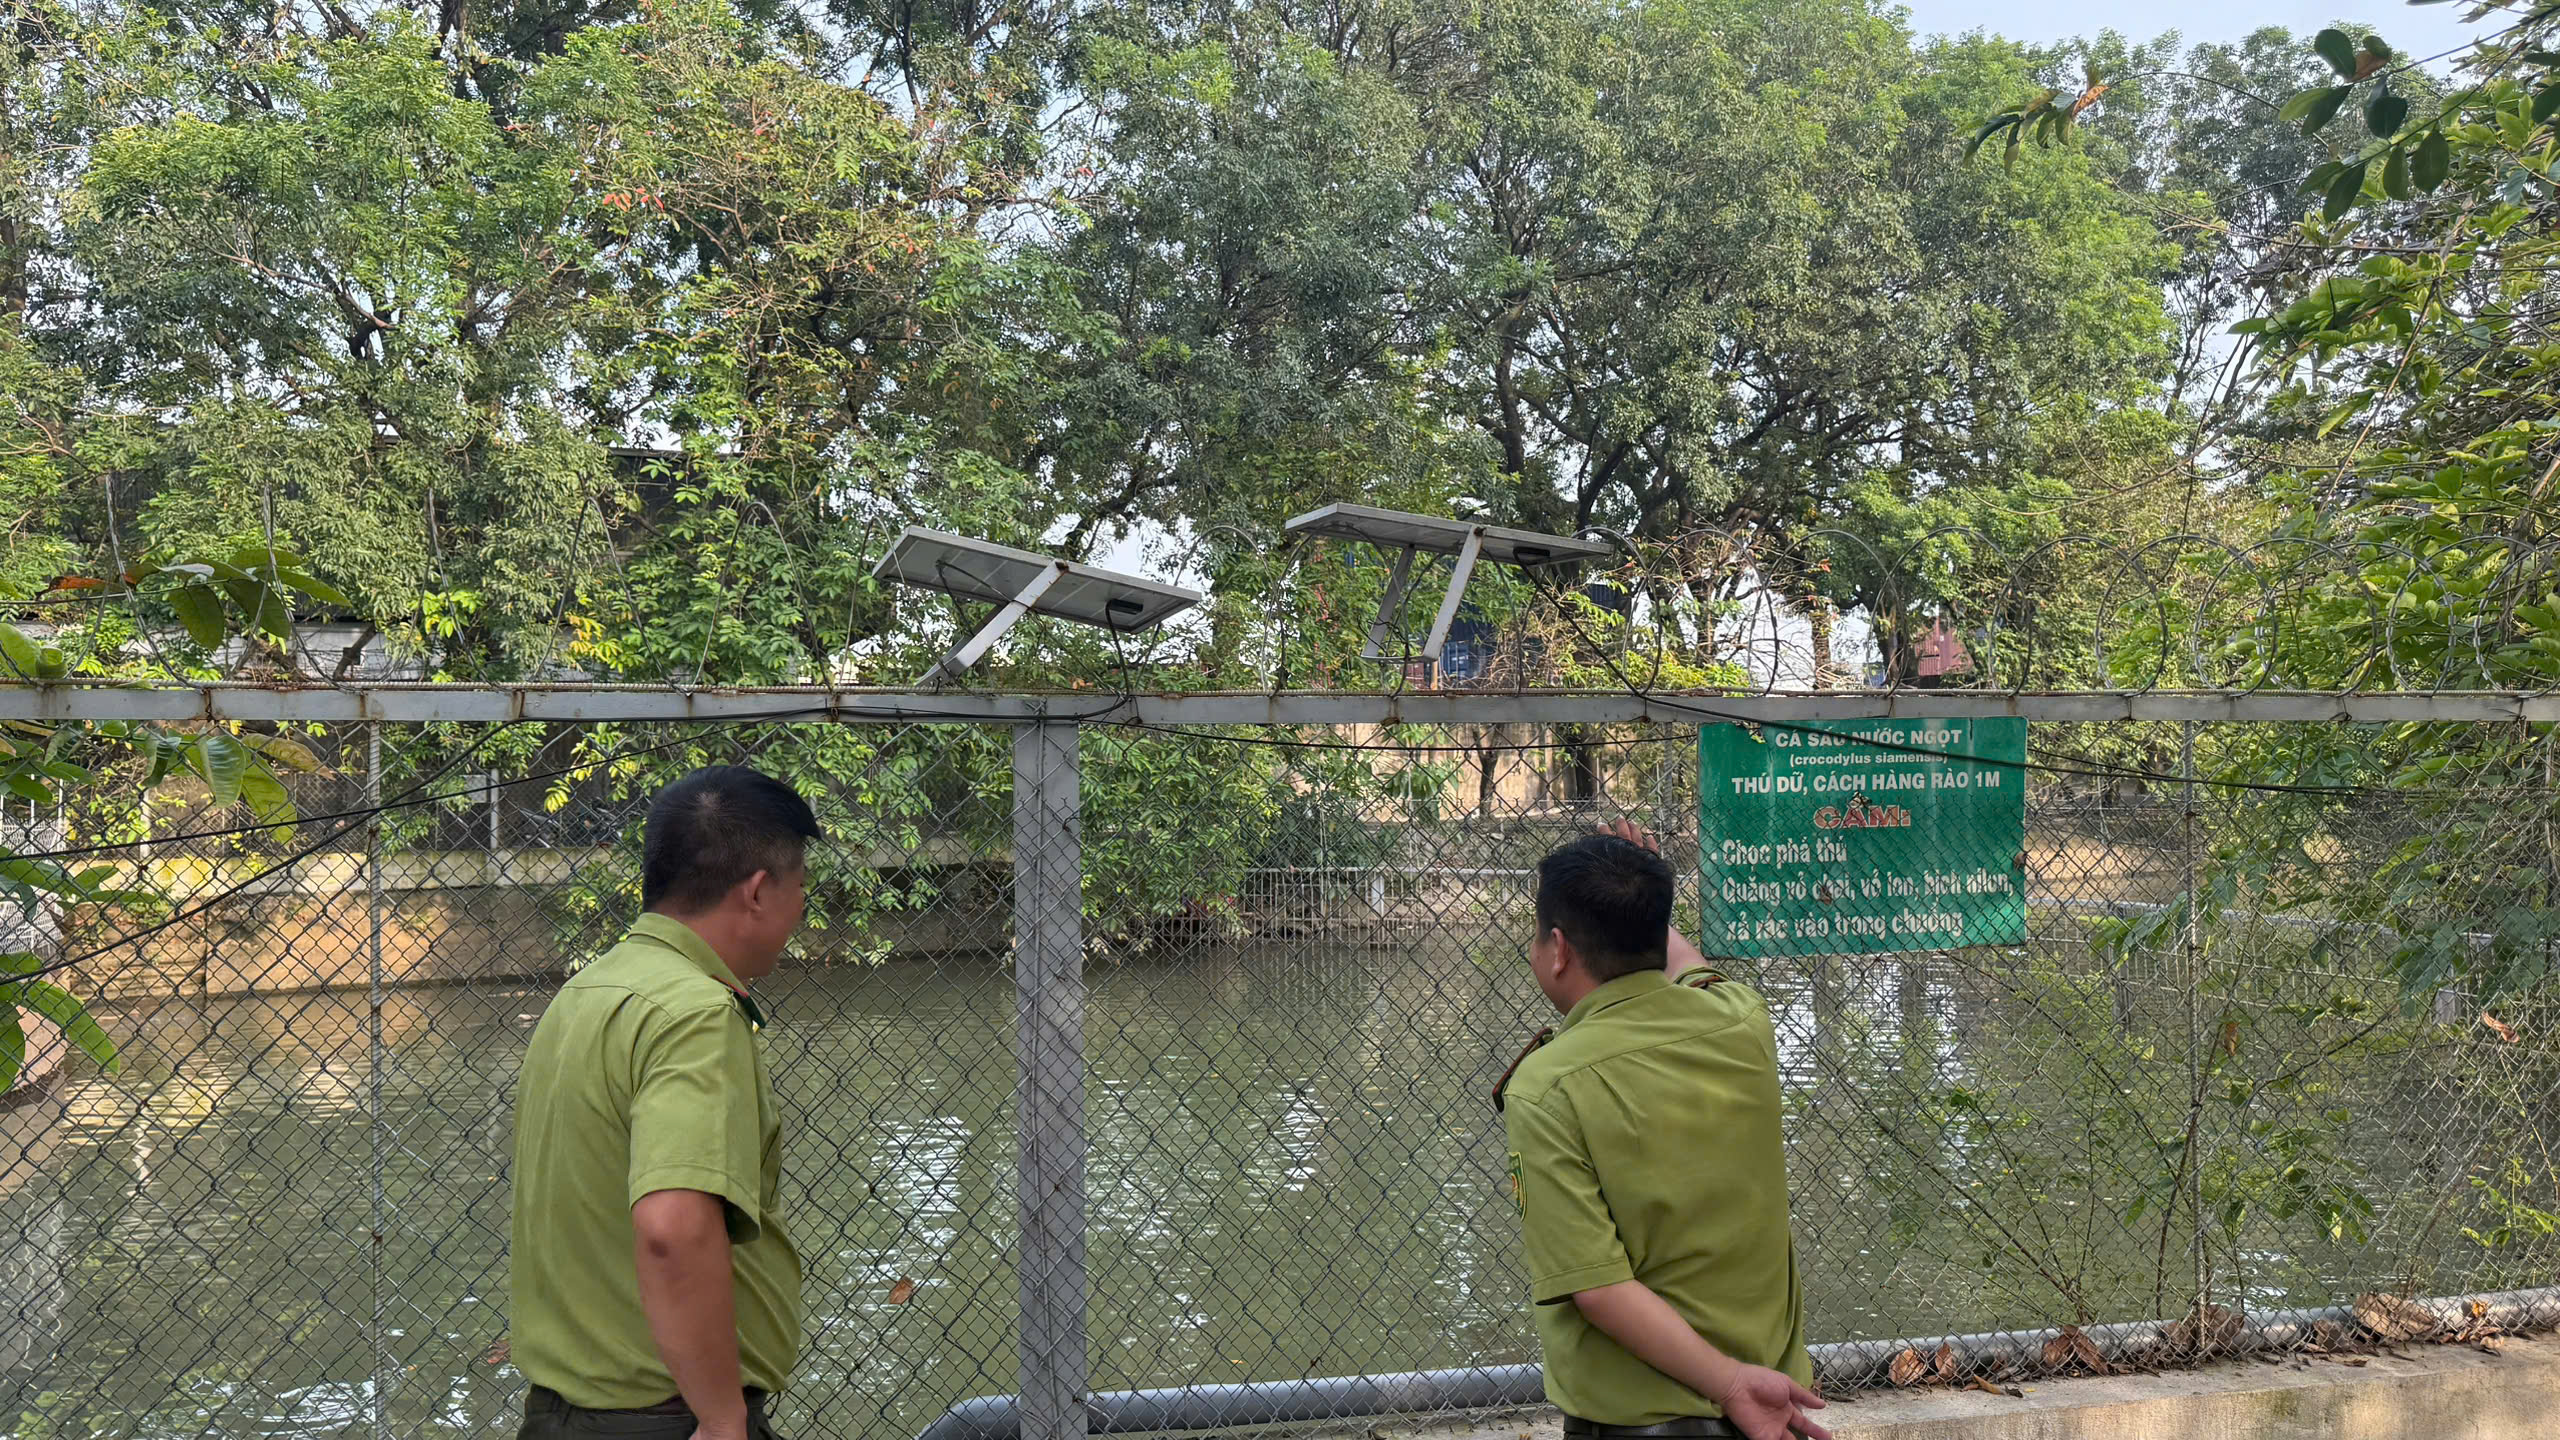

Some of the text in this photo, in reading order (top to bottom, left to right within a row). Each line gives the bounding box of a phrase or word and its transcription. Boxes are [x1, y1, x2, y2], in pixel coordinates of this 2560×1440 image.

[1775, 729, 1802, 748] CÁ
[1910, 729, 1962, 748] NGỌT
[1789, 753, 1872, 768] (crocodylus
[1731, 768, 2000, 795] THÚ DỮ, CÁCH HÀNG RÀO 1M
[1722, 839, 1771, 872] Chọc
[1816, 835, 1847, 863] thú
[1722, 876, 1780, 906] Quăng
[1887, 872, 1919, 901] lon,
[1726, 911, 1749, 941] xả
[1756, 912, 1788, 939] rác
[1795, 912, 1829, 938] vào
[1834, 911, 1885, 940] trong
